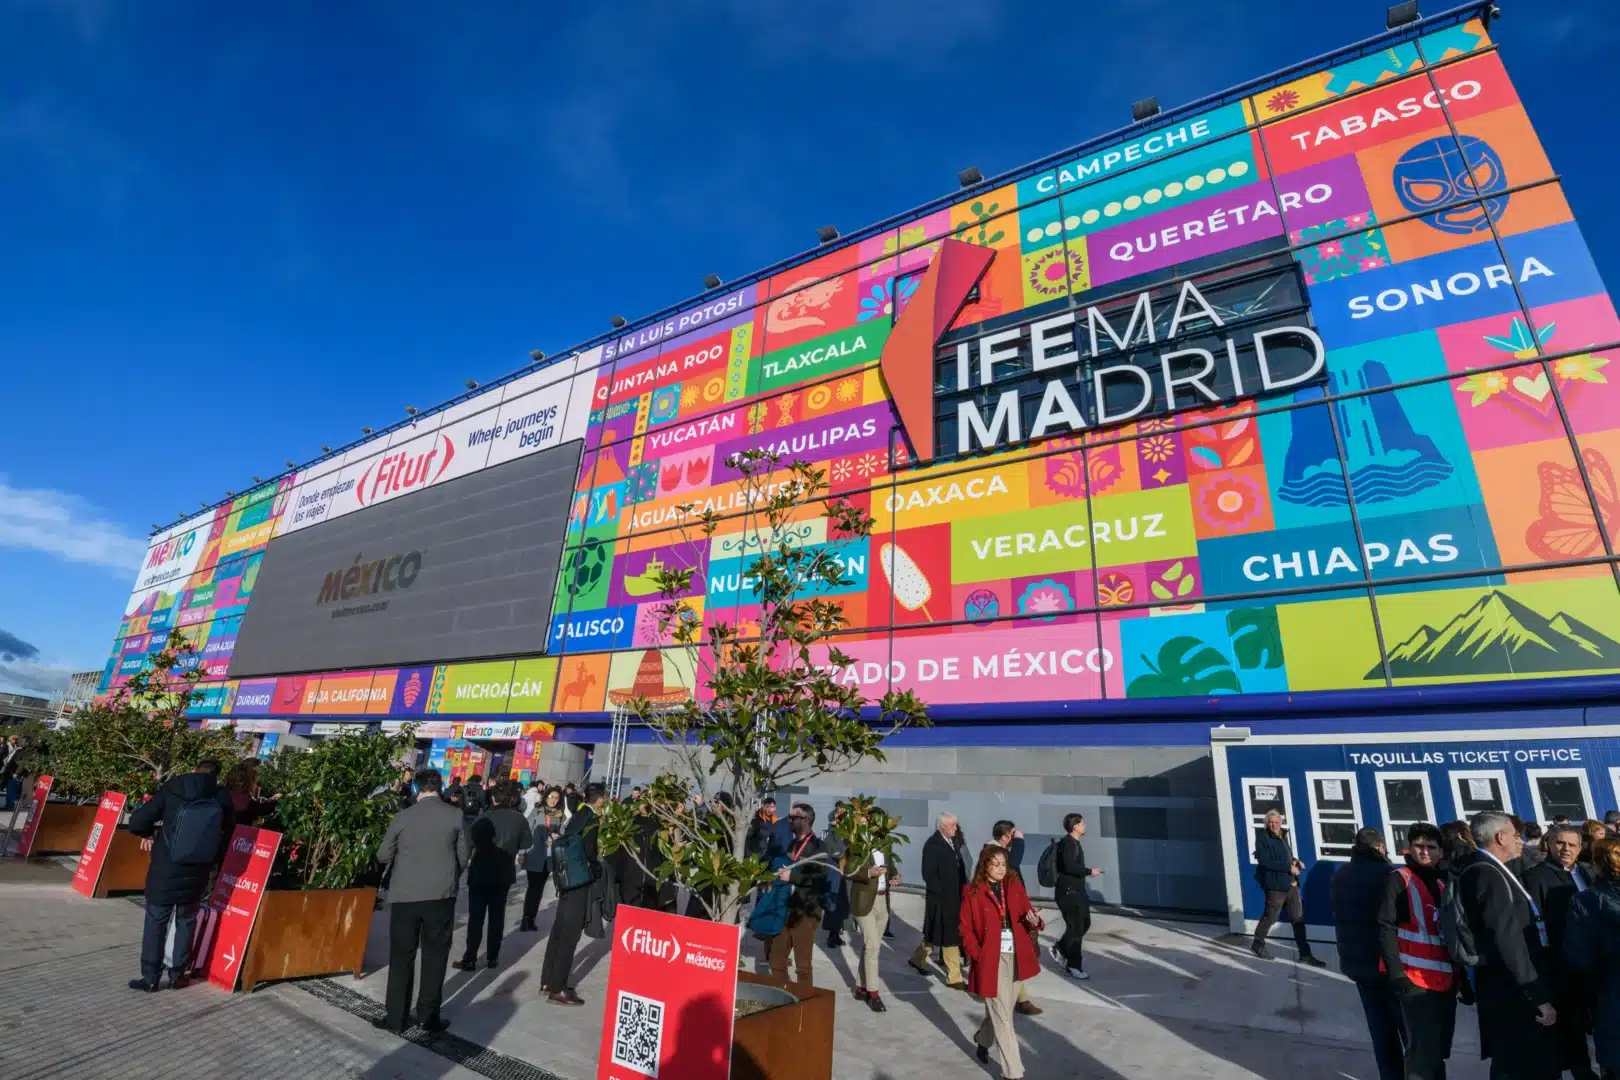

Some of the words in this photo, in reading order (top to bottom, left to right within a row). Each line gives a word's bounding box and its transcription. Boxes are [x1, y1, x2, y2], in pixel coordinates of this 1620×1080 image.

[1291, 79, 1482, 150] TABASCO
[1035, 119, 1210, 193] CAMPECHE
[1109, 183, 1333, 262] QUERÉTARO
[1348, 256, 1554, 318] SONORA
[605, 338, 635, 359] SAN
[640, 321, 674, 346] LUIS
[679, 291, 744, 330] POTOSÍ
[956, 280, 1224, 391] IFEMA
[597, 361, 678, 400] QUINTANA
[684, 345, 723, 369] ROO
[763, 336, 867, 378] TLAXCALA
[957, 325, 1325, 454] MADRID
[468, 425, 503, 448] Where
[503, 404, 557, 440] journeys
[519, 424, 554, 449] begin
[651, 412, 735, 449] YUCATÁN
[299, 491, 320, 509] Donde
[320, 478, 355, 502] empiezan
[885, 475, 1008, 512] OAXACA
[293, 511, 304, 523] los
[306, 504, 325, 520] viajes
[971, 513, 1166, 560] VERACRUZ
[1241, 533, 1459, 583] CHIAPAS
[555, 616, 625, 640] JALISCO
[918, 656, 960, 682] DE
[973, 645, 1114, 680] MÉXICO
[236, 694, 270, 706] DURANGO
[307, 689, 329, 703] BAJA
[331, 687, 387, 703] CALIFORNIA
[456, 678, 543, 699] MICHOACÁN
[1350, 752, 1445, 765] TAQUILLAS
[1448, 751, 1510, 764] TICKET
[1514, 748, 1582, 762] OFFICE
[250, 882, 259, 894] 12
